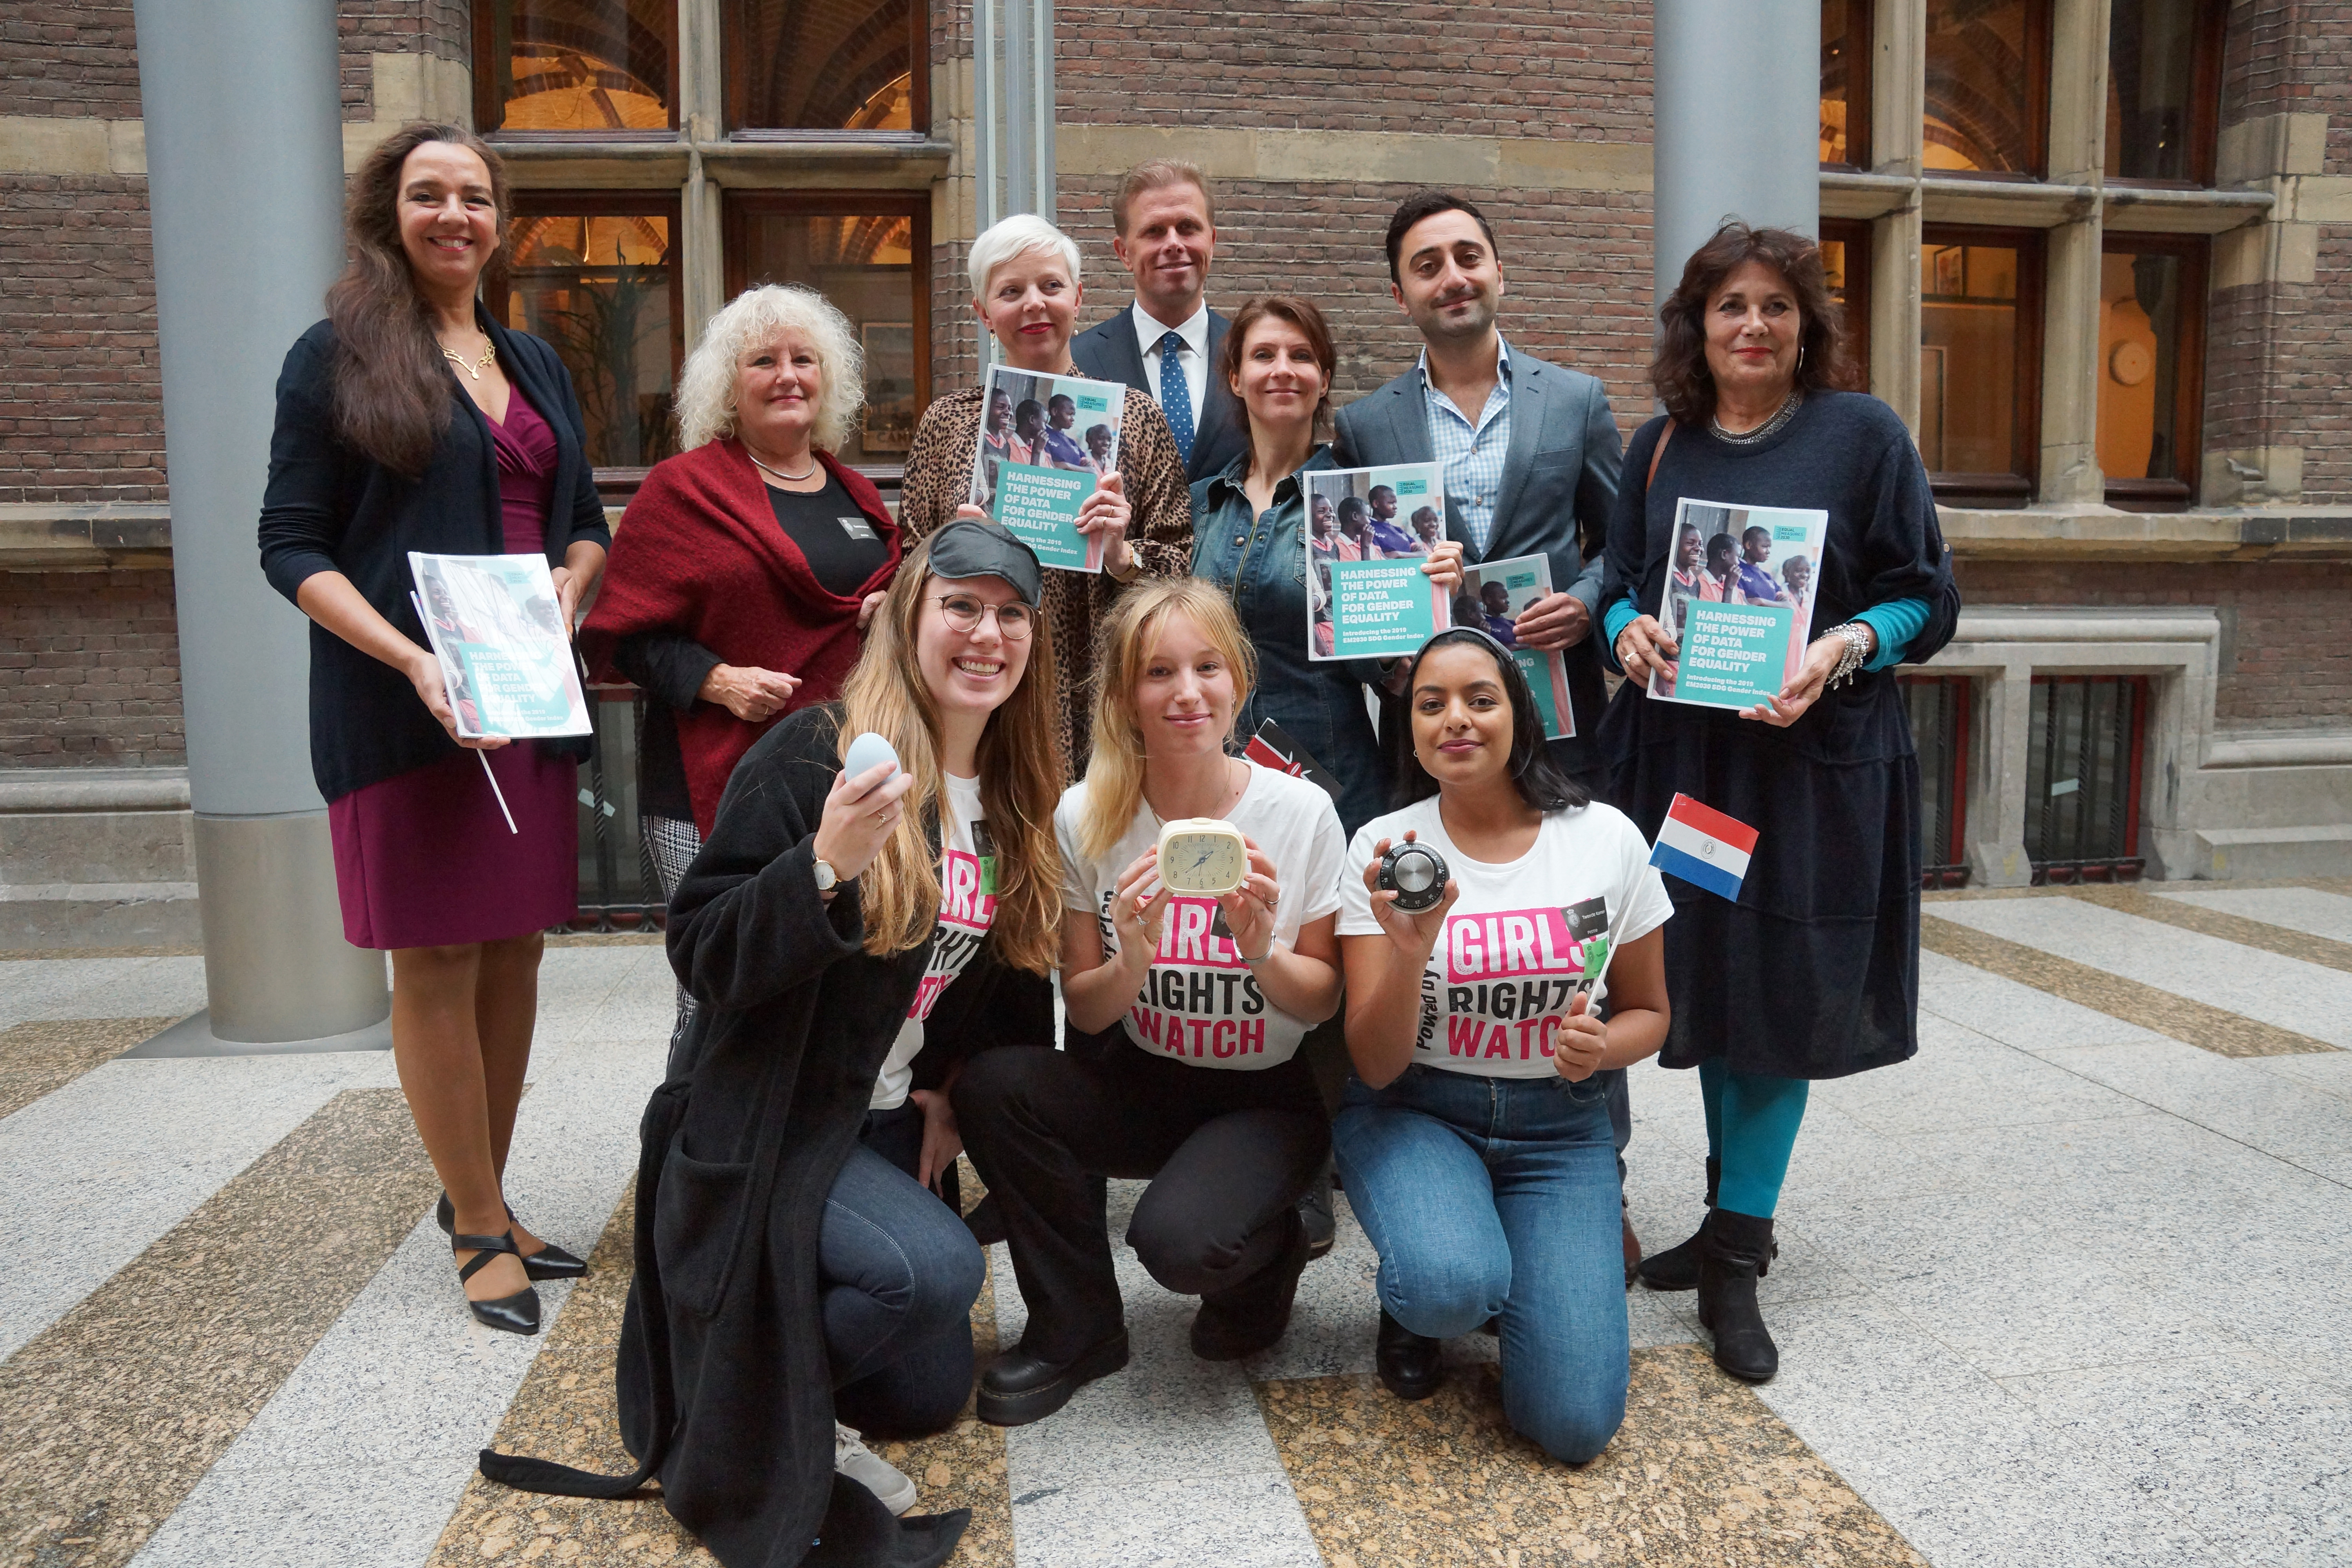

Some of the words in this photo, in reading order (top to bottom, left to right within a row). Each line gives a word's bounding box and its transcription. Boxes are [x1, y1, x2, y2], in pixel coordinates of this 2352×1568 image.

[1007, 472, 1081, 490] HARNESSING
[1006, 483, 1028, 494] THE
[1030, 486, 1071, 500] POWER
[1004, 494, 1020, 503] OF
[1022, 496, 1050, 508] DATA
[1003, 505, 1025, 516] FOR
[1027, 509, 1073, 523] GENDER
[1001, 516, 1058, 532] EQUALITY
[1340, 567, 1416, 580] HARNESSING
[1341, 581, 1364, 591] THE
[1366, 579, 1408, 590] POWER
[1341, 593, 1357, 602] OF
[1359, 591, 1389, 601] DATA
[1342, 603, 1365, 613] FOR
[1367, 600, 1414, 611] GENDER
[1342, 612, 1400, 624] EQUALITY
[1697, 610, 1776, 627] HARNESSING
[1695, 622, 1719, 633] THE
[1720, 625, 1765, 638] POWER
[1693, 633, 1710, 644] OF
[1711, 635, 1742, 648] DATA
[469, 652, 542, 660] HARNESSING
[1691, 645, 1716, 657] FOR
[1717, 648, 1766, 662] GENDER
[472, 662, 495, 671] THE
[496, 662, 535, 671] POWER
[1689, 657, 1750, 673] EQUALITY
[476, 673, 490, 681] OF
[1686, 674, 1725, 684] Introducing
[478, 684, 501, 692] FOR
[503, 684, 547, 692] GENDER
[482, 694, 535, 703] EQUALITY
[941, 855, 998, 924] IRL
[1098, 891, 1113, 938] Plan
[1161, 903, 1232, 963] IRL
[1422, 969, 1441, 991] by
[1131, 1006, 1265, 1058] WATCH
[1448, 1015, 1562, 1060] WATC
